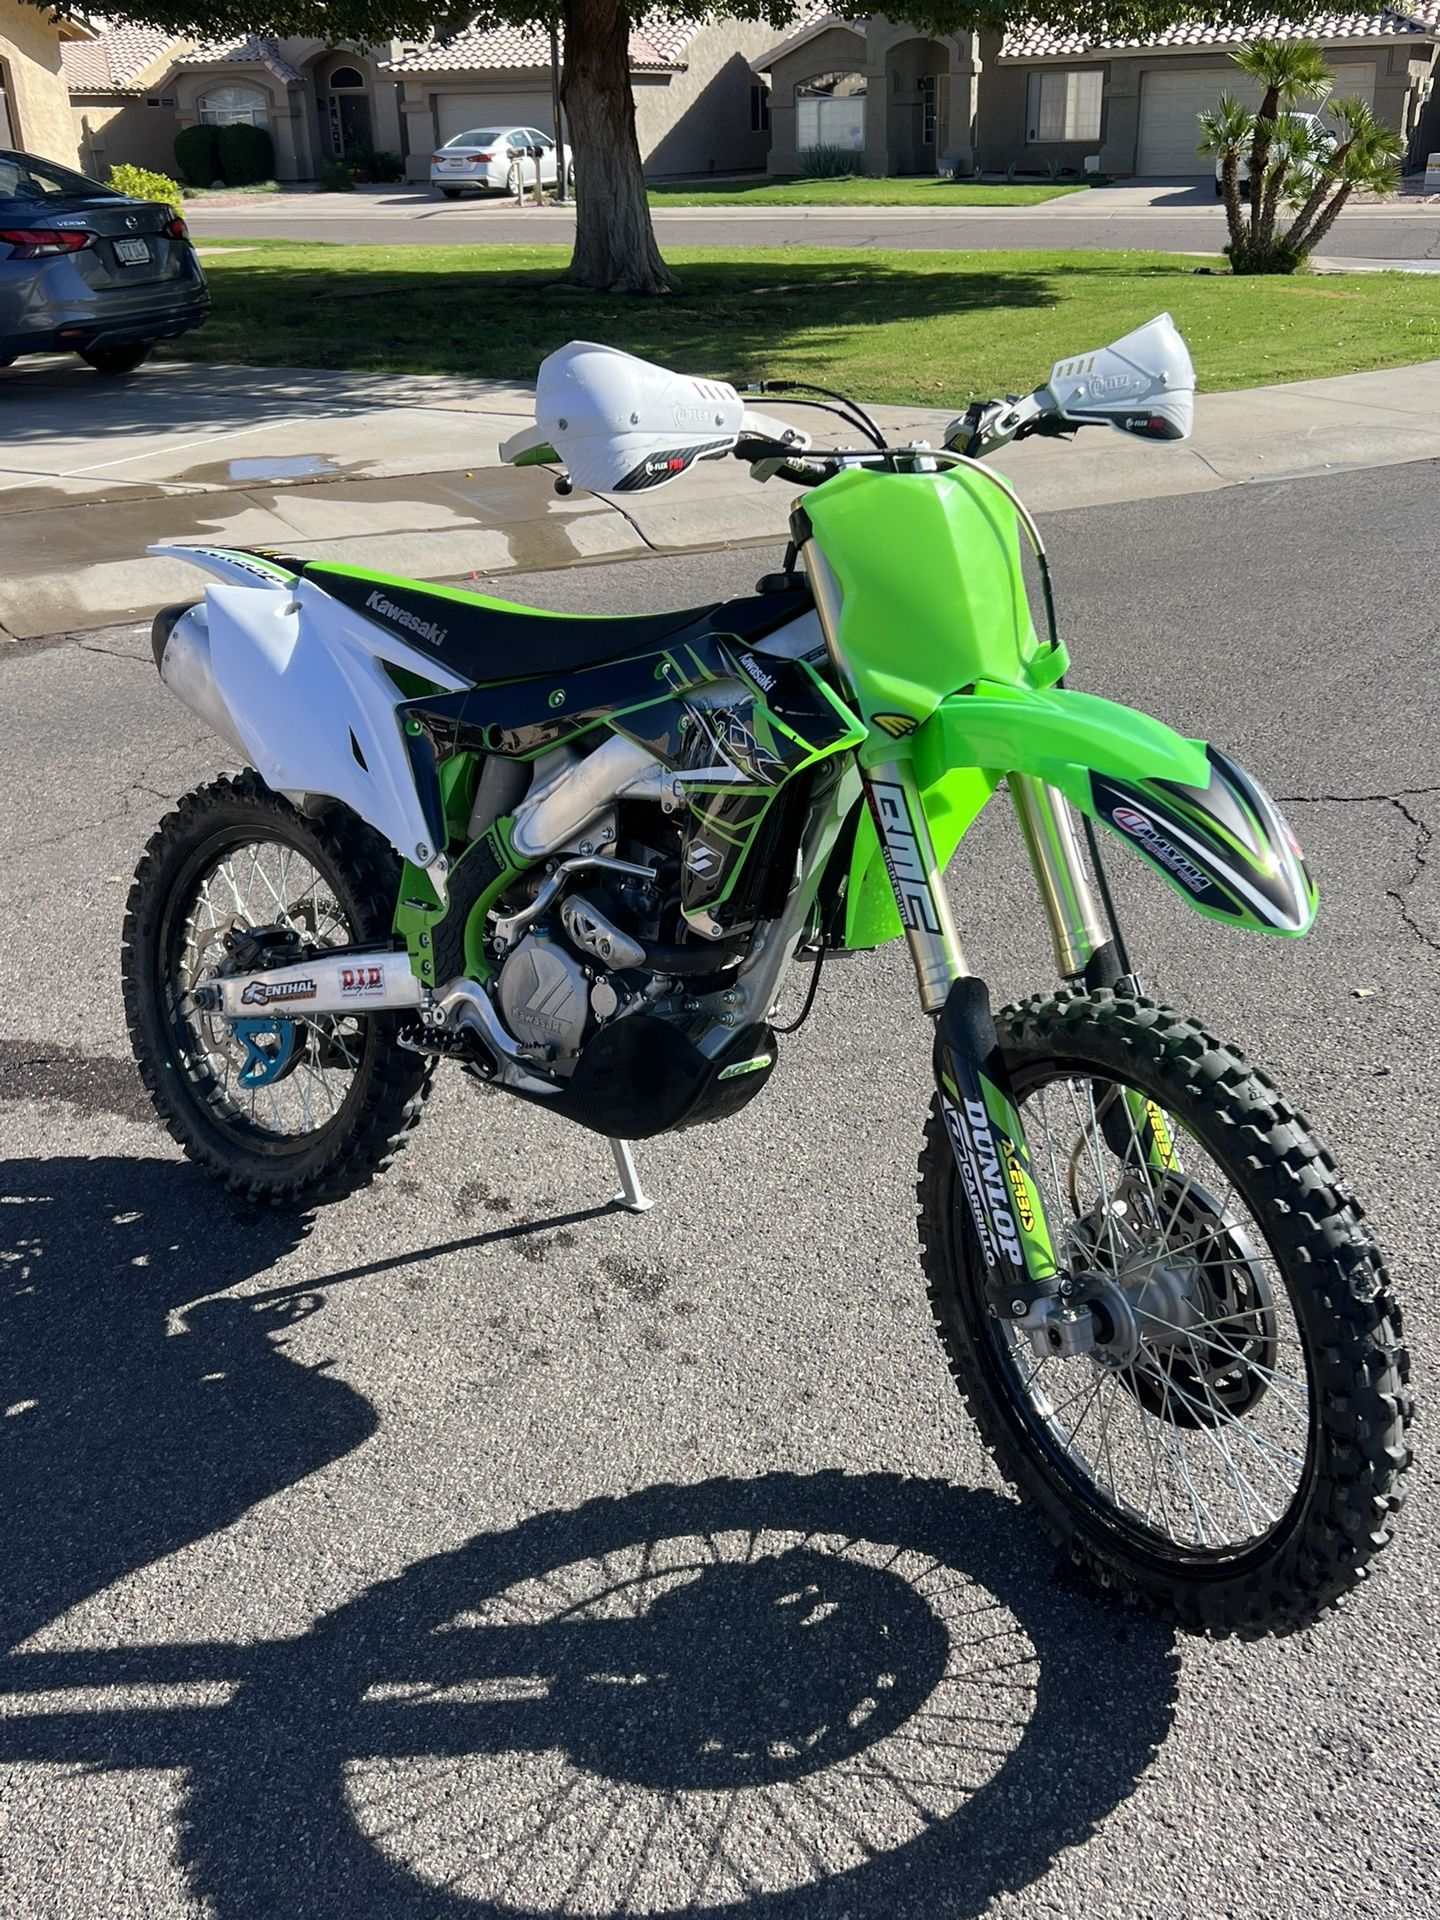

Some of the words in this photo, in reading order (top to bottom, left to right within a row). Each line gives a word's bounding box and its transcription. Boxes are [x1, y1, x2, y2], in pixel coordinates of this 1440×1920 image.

[668, 458, 685, 471] PRO
[365, 590, 448, 647] Kawasaki
[738, 652, 777, 693] Kawasaki
[883, 845, 909, 926] SUSPENSION
[510, 1004, 563, 1035] Kawasaki
[962, 1162, 996, 1267] CARRILLO
[964, 1098, 1024, 1266] DUNLOP
[1001, 1137, 1036, 1233] ACERBIS
